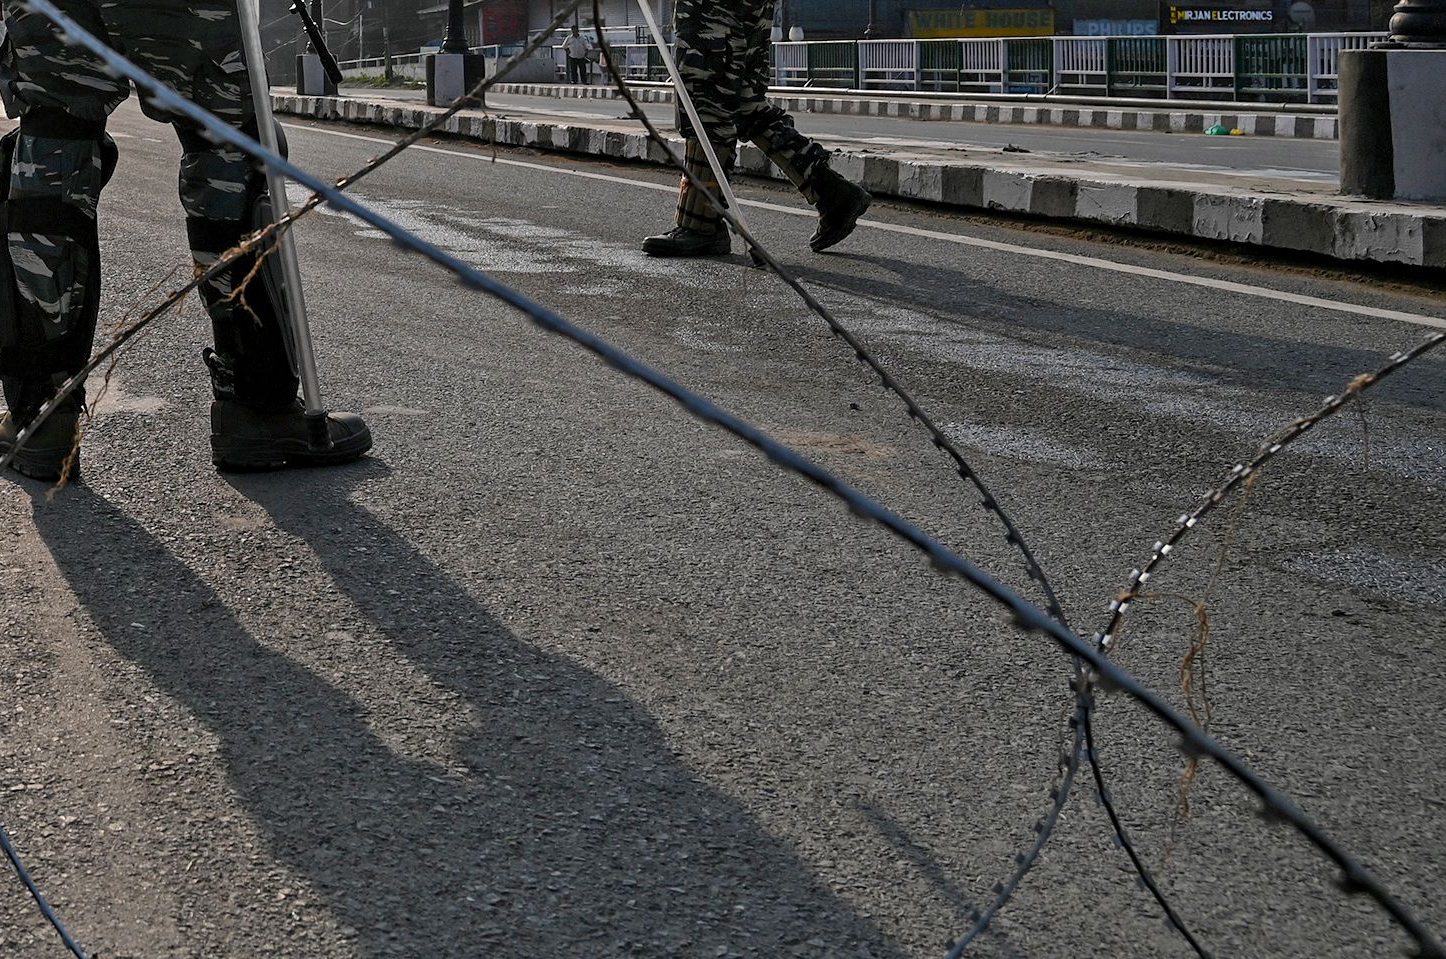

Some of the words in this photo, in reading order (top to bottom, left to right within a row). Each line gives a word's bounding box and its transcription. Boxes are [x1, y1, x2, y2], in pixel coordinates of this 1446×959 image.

[916, 14, 975, 30] WHITE
[985, 11, 1051, 28] HOUSE
[1177, 10, 1211, 21] MIRJAN
[1212, 10, 1273, 21] ELECTRONICS
